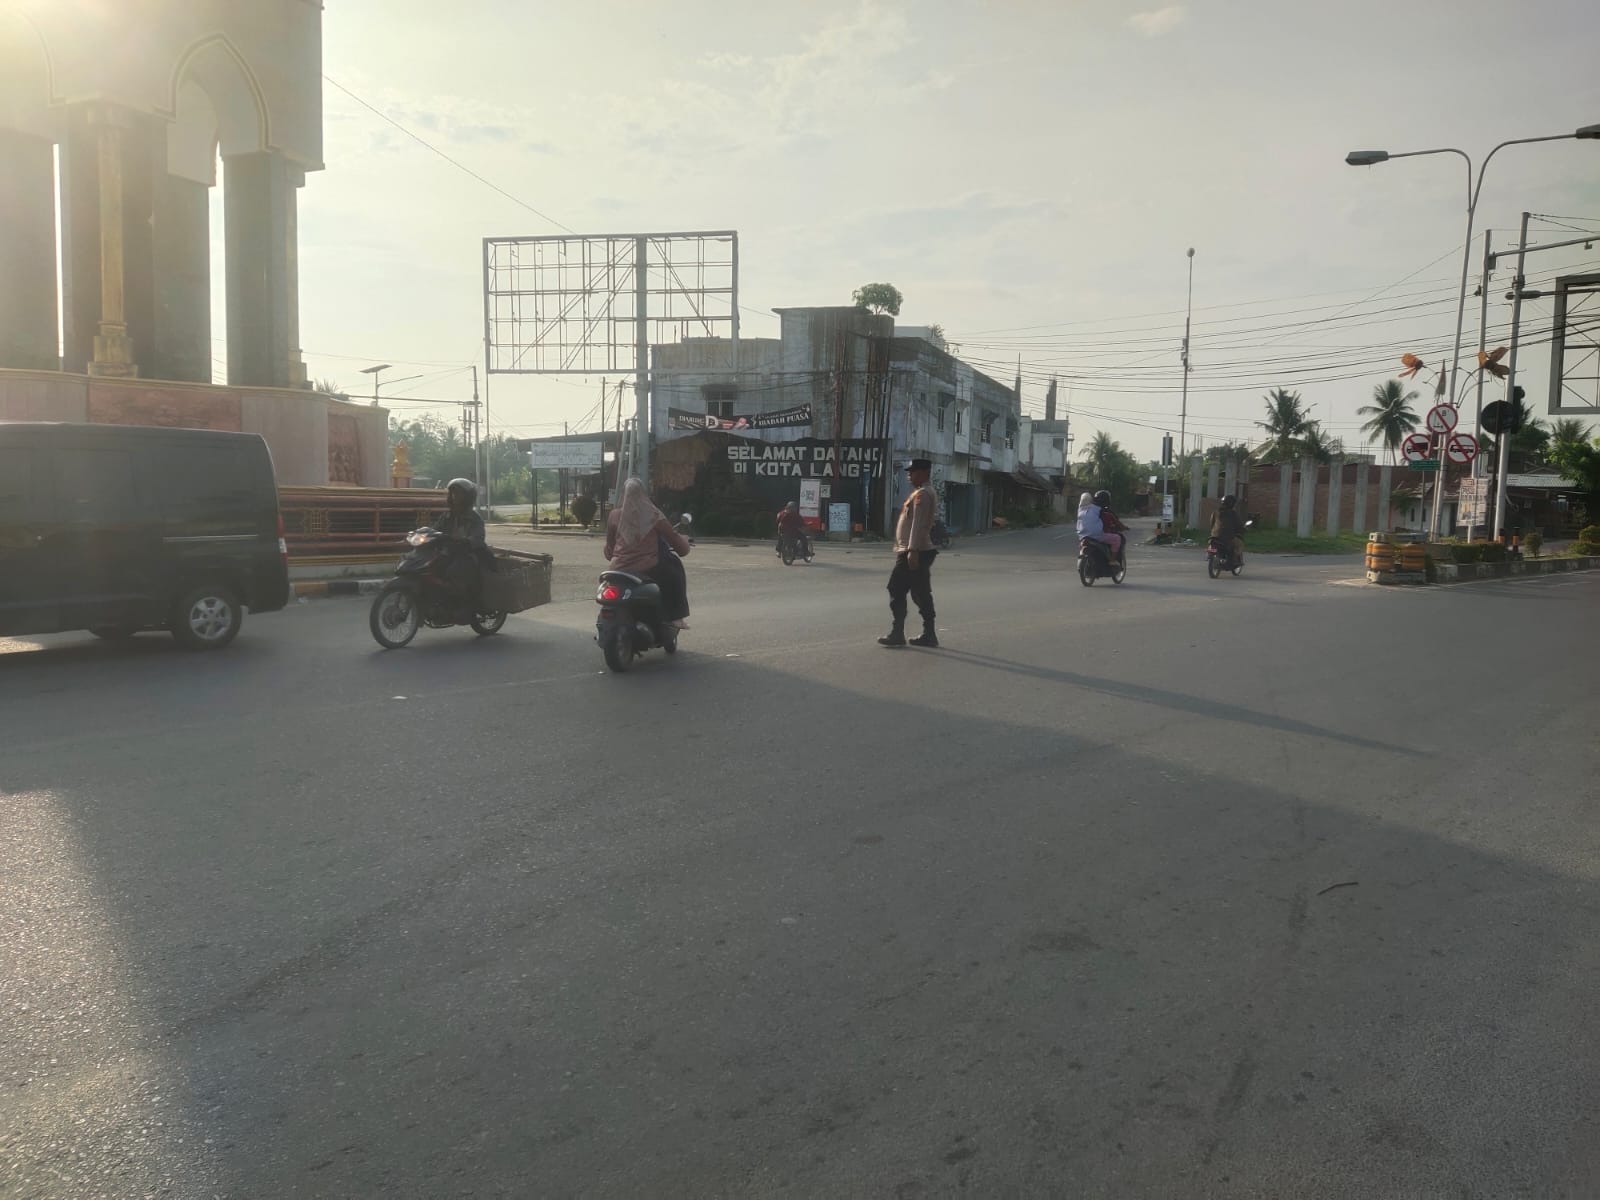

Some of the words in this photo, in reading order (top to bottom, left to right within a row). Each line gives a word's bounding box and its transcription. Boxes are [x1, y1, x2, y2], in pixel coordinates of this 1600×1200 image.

[727, 446, 807, 460] SELAMAT
[734, 462, 747, 473] DI
[755, 462, 802, 477] KOTA
